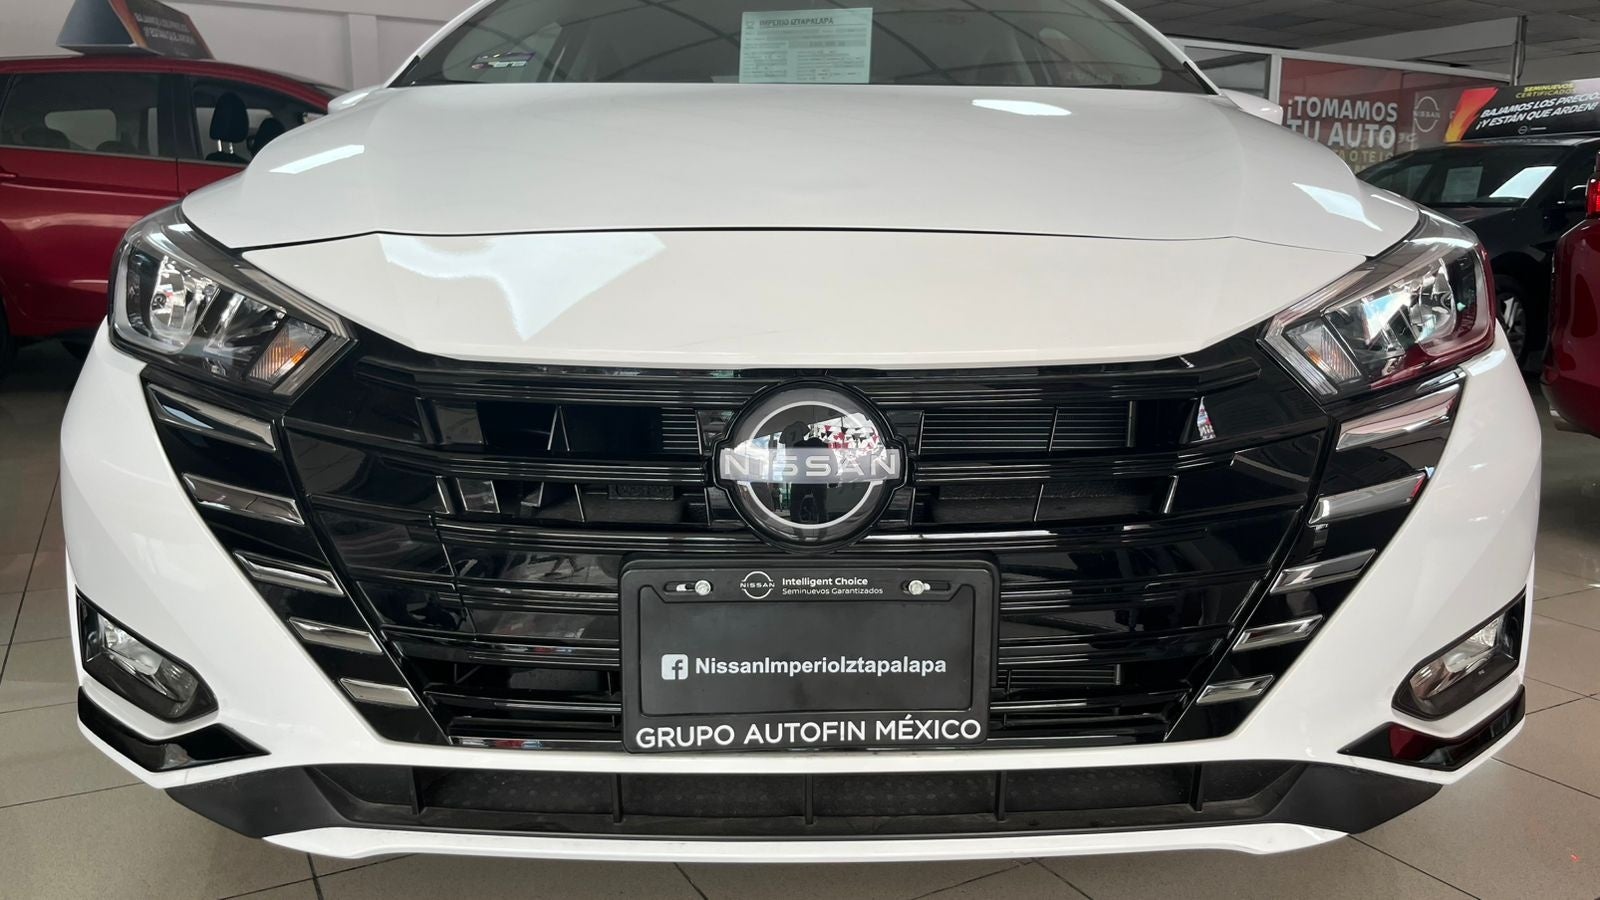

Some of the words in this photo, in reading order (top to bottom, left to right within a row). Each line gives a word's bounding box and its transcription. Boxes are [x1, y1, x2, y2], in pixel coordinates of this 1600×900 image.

[790, 17, 834, 25] IZTAPALAPA
[1515, 89, 1577, 98] CERTIFICADOS
[1523, 83, 1575, 93] SEMINUEVOS
[1286, 95, 1399, 123] ¡TOMAMOS
[1480, 102, 1534, 118] BAJAMOS
[1533, 98, 1556, 109] LOS
[1556, 92, 1600, 106] PRECIO
[1526, 108, 1553, 120] QUE
[1550, 101, 1599, 117] ARDEN!
[1328, 121, 1396, 149] AUTO
[724, 453, 896, 477] NISSAN
[782, 577, 833, 587] Intelligent
[834, 577, 868, 586] Choice
[782, 587, 830, 595] Seminuevos
[831, 587, 883, 595] Garantizados
[695, 656, 946, 677] NissanImperioIztapalapa
[635, 725, 735, 748] GRUPO
[743, 721, 865, 745] AUTOFIN
[875, 714, 982, 741] MÉXICO
